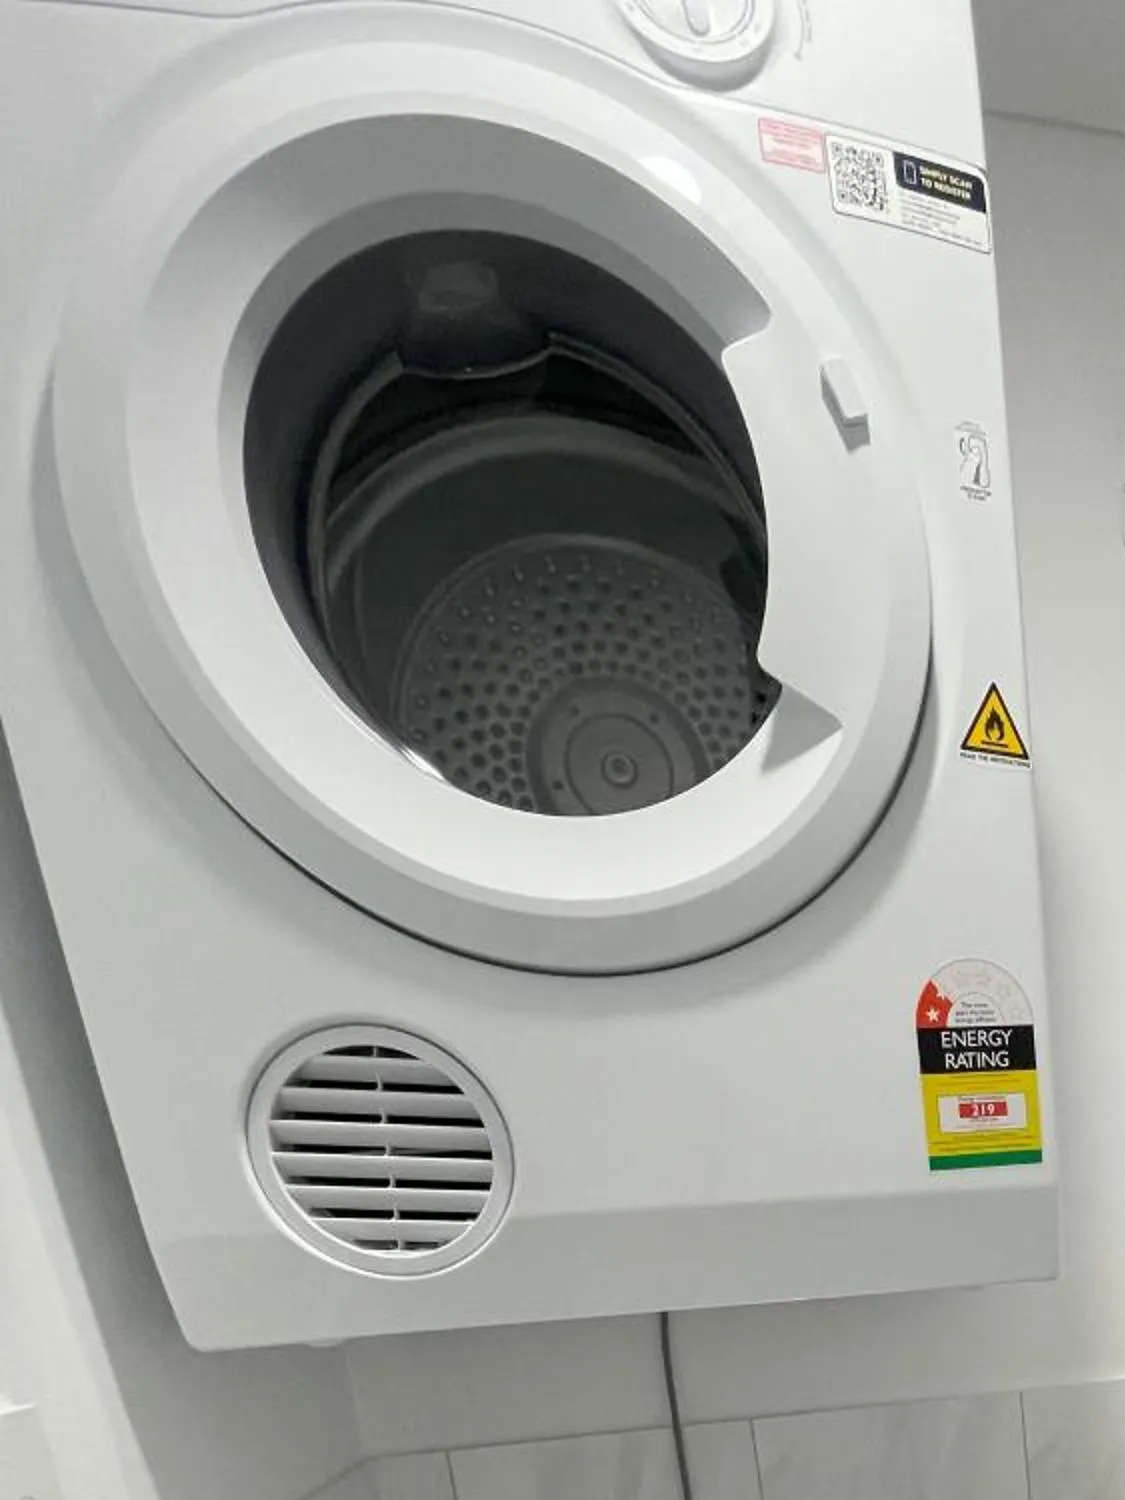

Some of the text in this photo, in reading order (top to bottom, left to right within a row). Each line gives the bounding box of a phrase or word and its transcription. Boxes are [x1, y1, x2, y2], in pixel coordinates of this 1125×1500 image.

[921, 177, 933, 189] TO
[941, 1029, 1012, 1049] ENERGY
[945, 1051, 1010, 1069] RATING
[972, 1103, 995, 1116] 219
